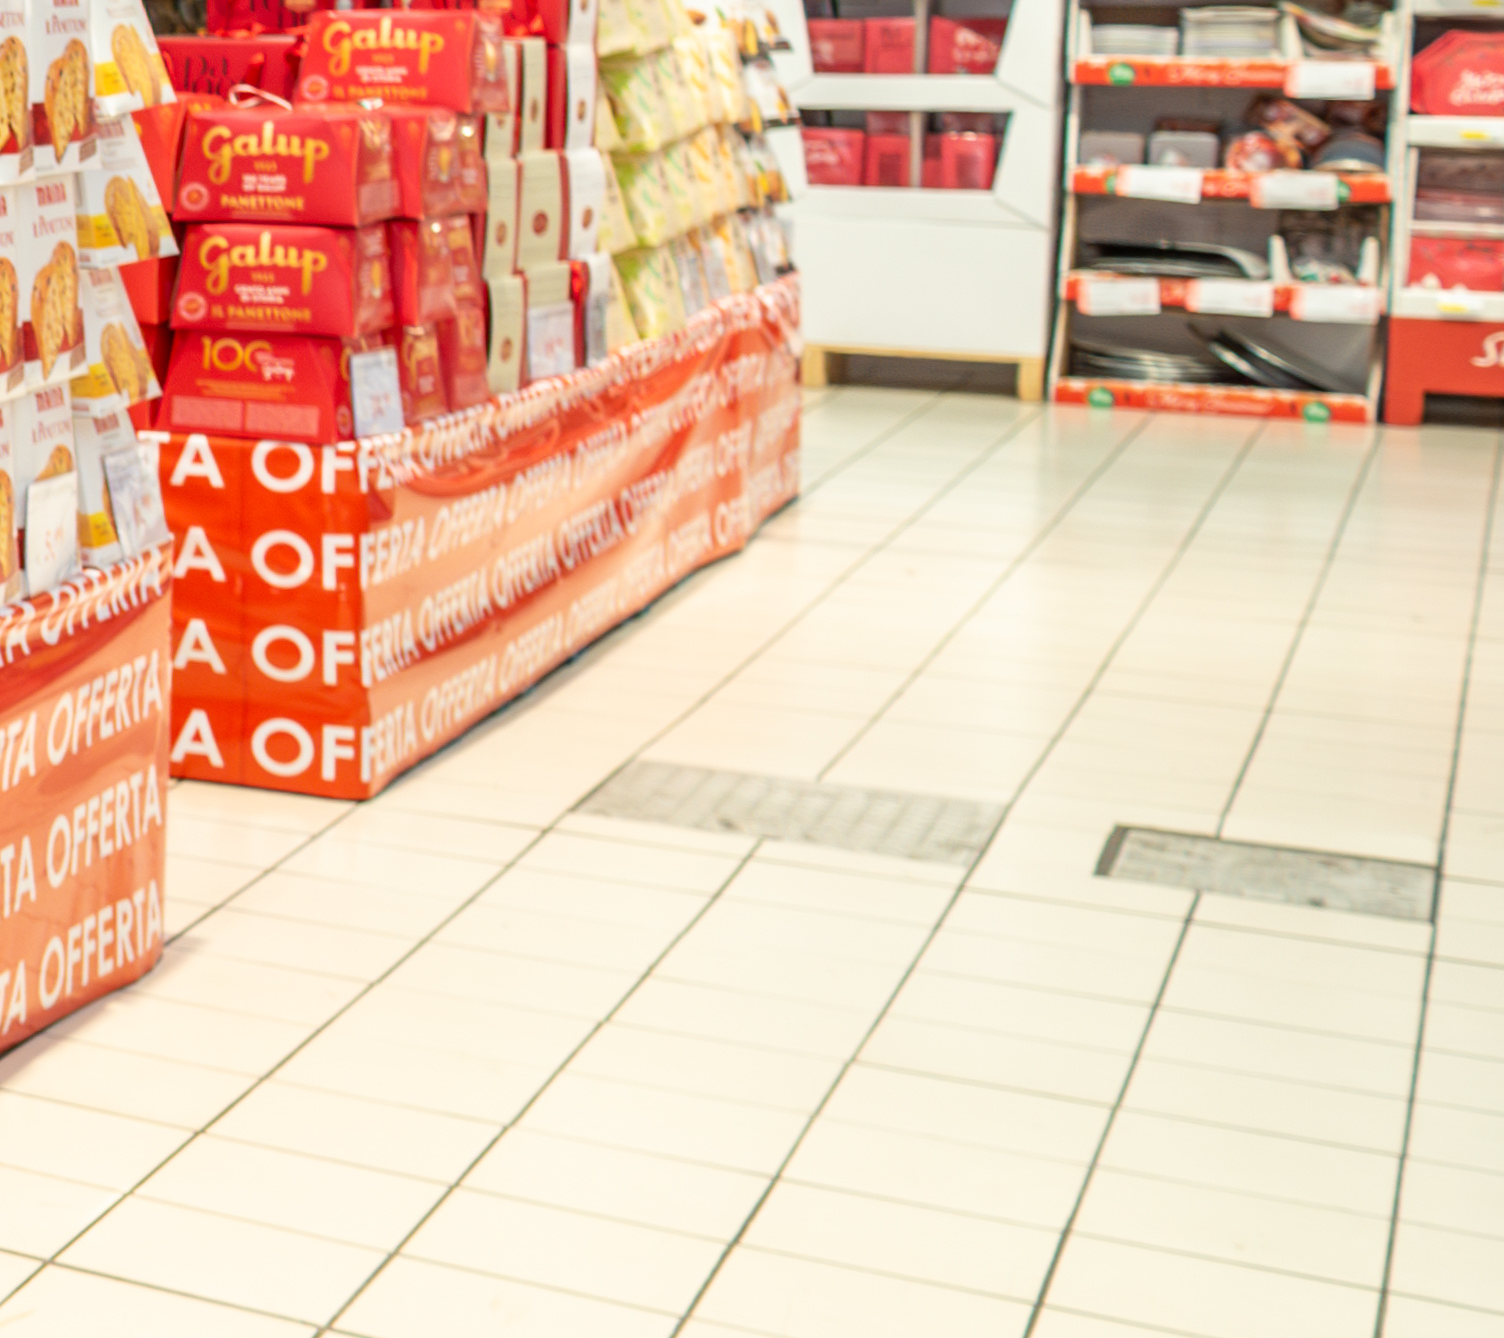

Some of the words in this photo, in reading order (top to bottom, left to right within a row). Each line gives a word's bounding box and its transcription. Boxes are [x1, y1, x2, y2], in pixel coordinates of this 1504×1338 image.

[323, 16, 444, 76] Galup
[202, 121, 329, 184] Galup
[199, 232, 327, 295] Galup
